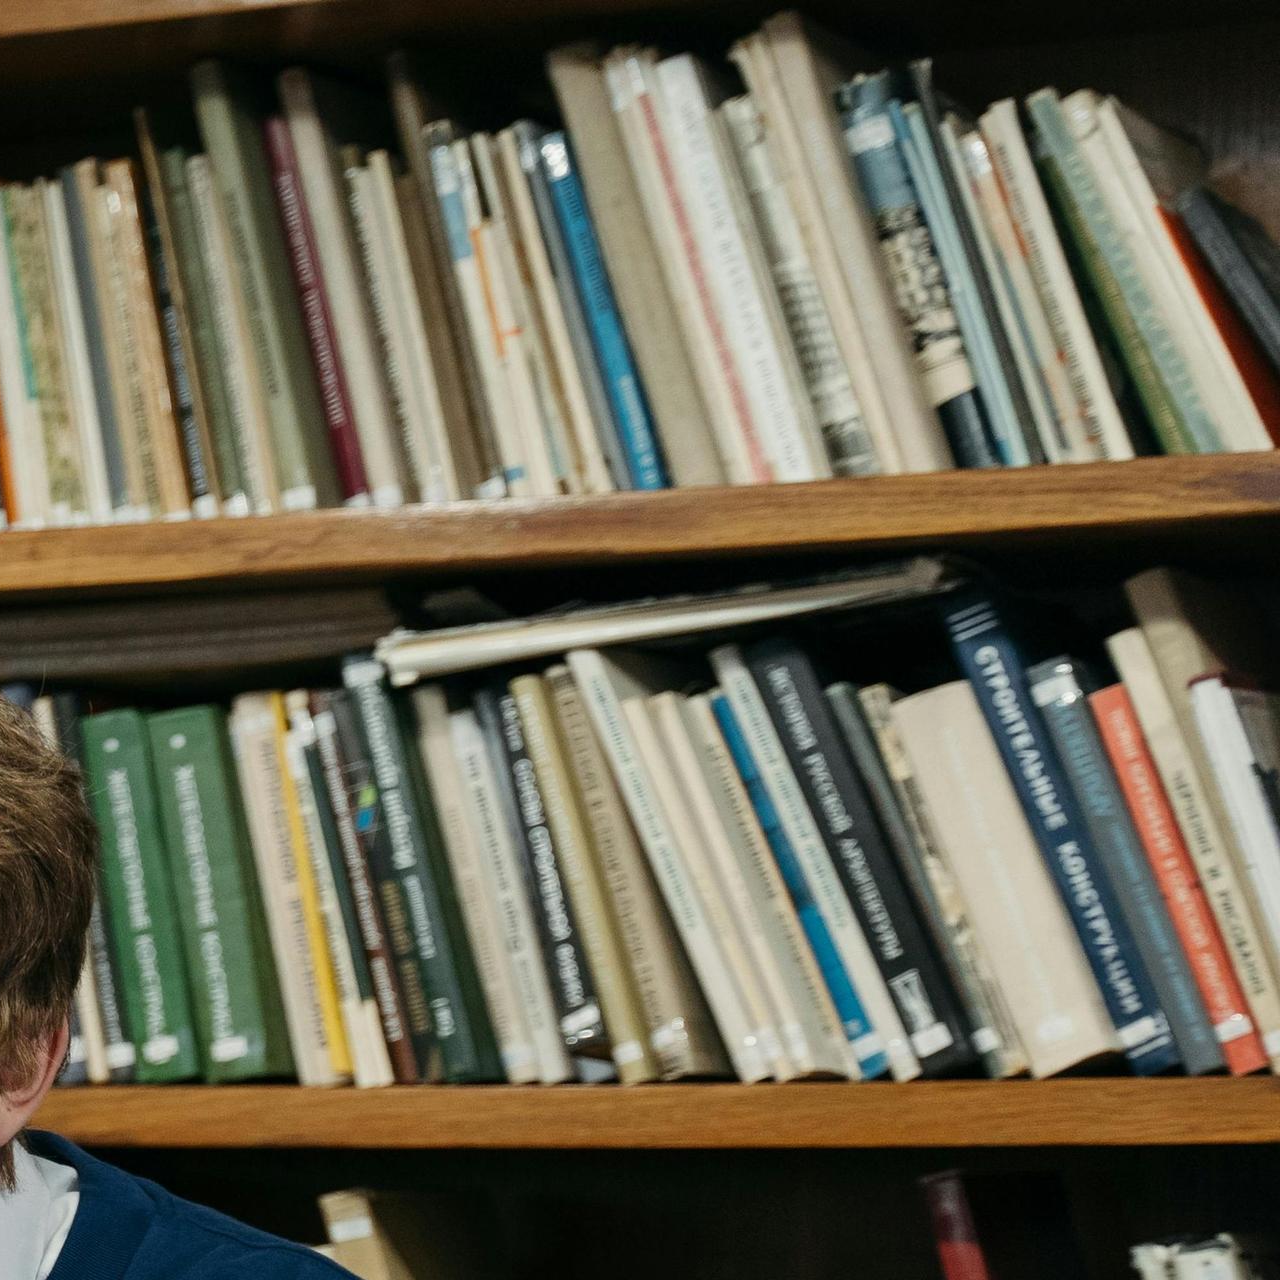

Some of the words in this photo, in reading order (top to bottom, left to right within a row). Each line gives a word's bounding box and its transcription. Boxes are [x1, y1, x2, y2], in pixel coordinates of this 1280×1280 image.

[768, 663, 817, 751] ИСТОРИЯ
[835, 837, 901, 961] АРХИТЕКТУРЫ
[974, 644, 1066, 831] СТРОИТЕЛЬНЫЕ
[1057, 840, 1144, 1014] КОНСТРУКЦИИ
